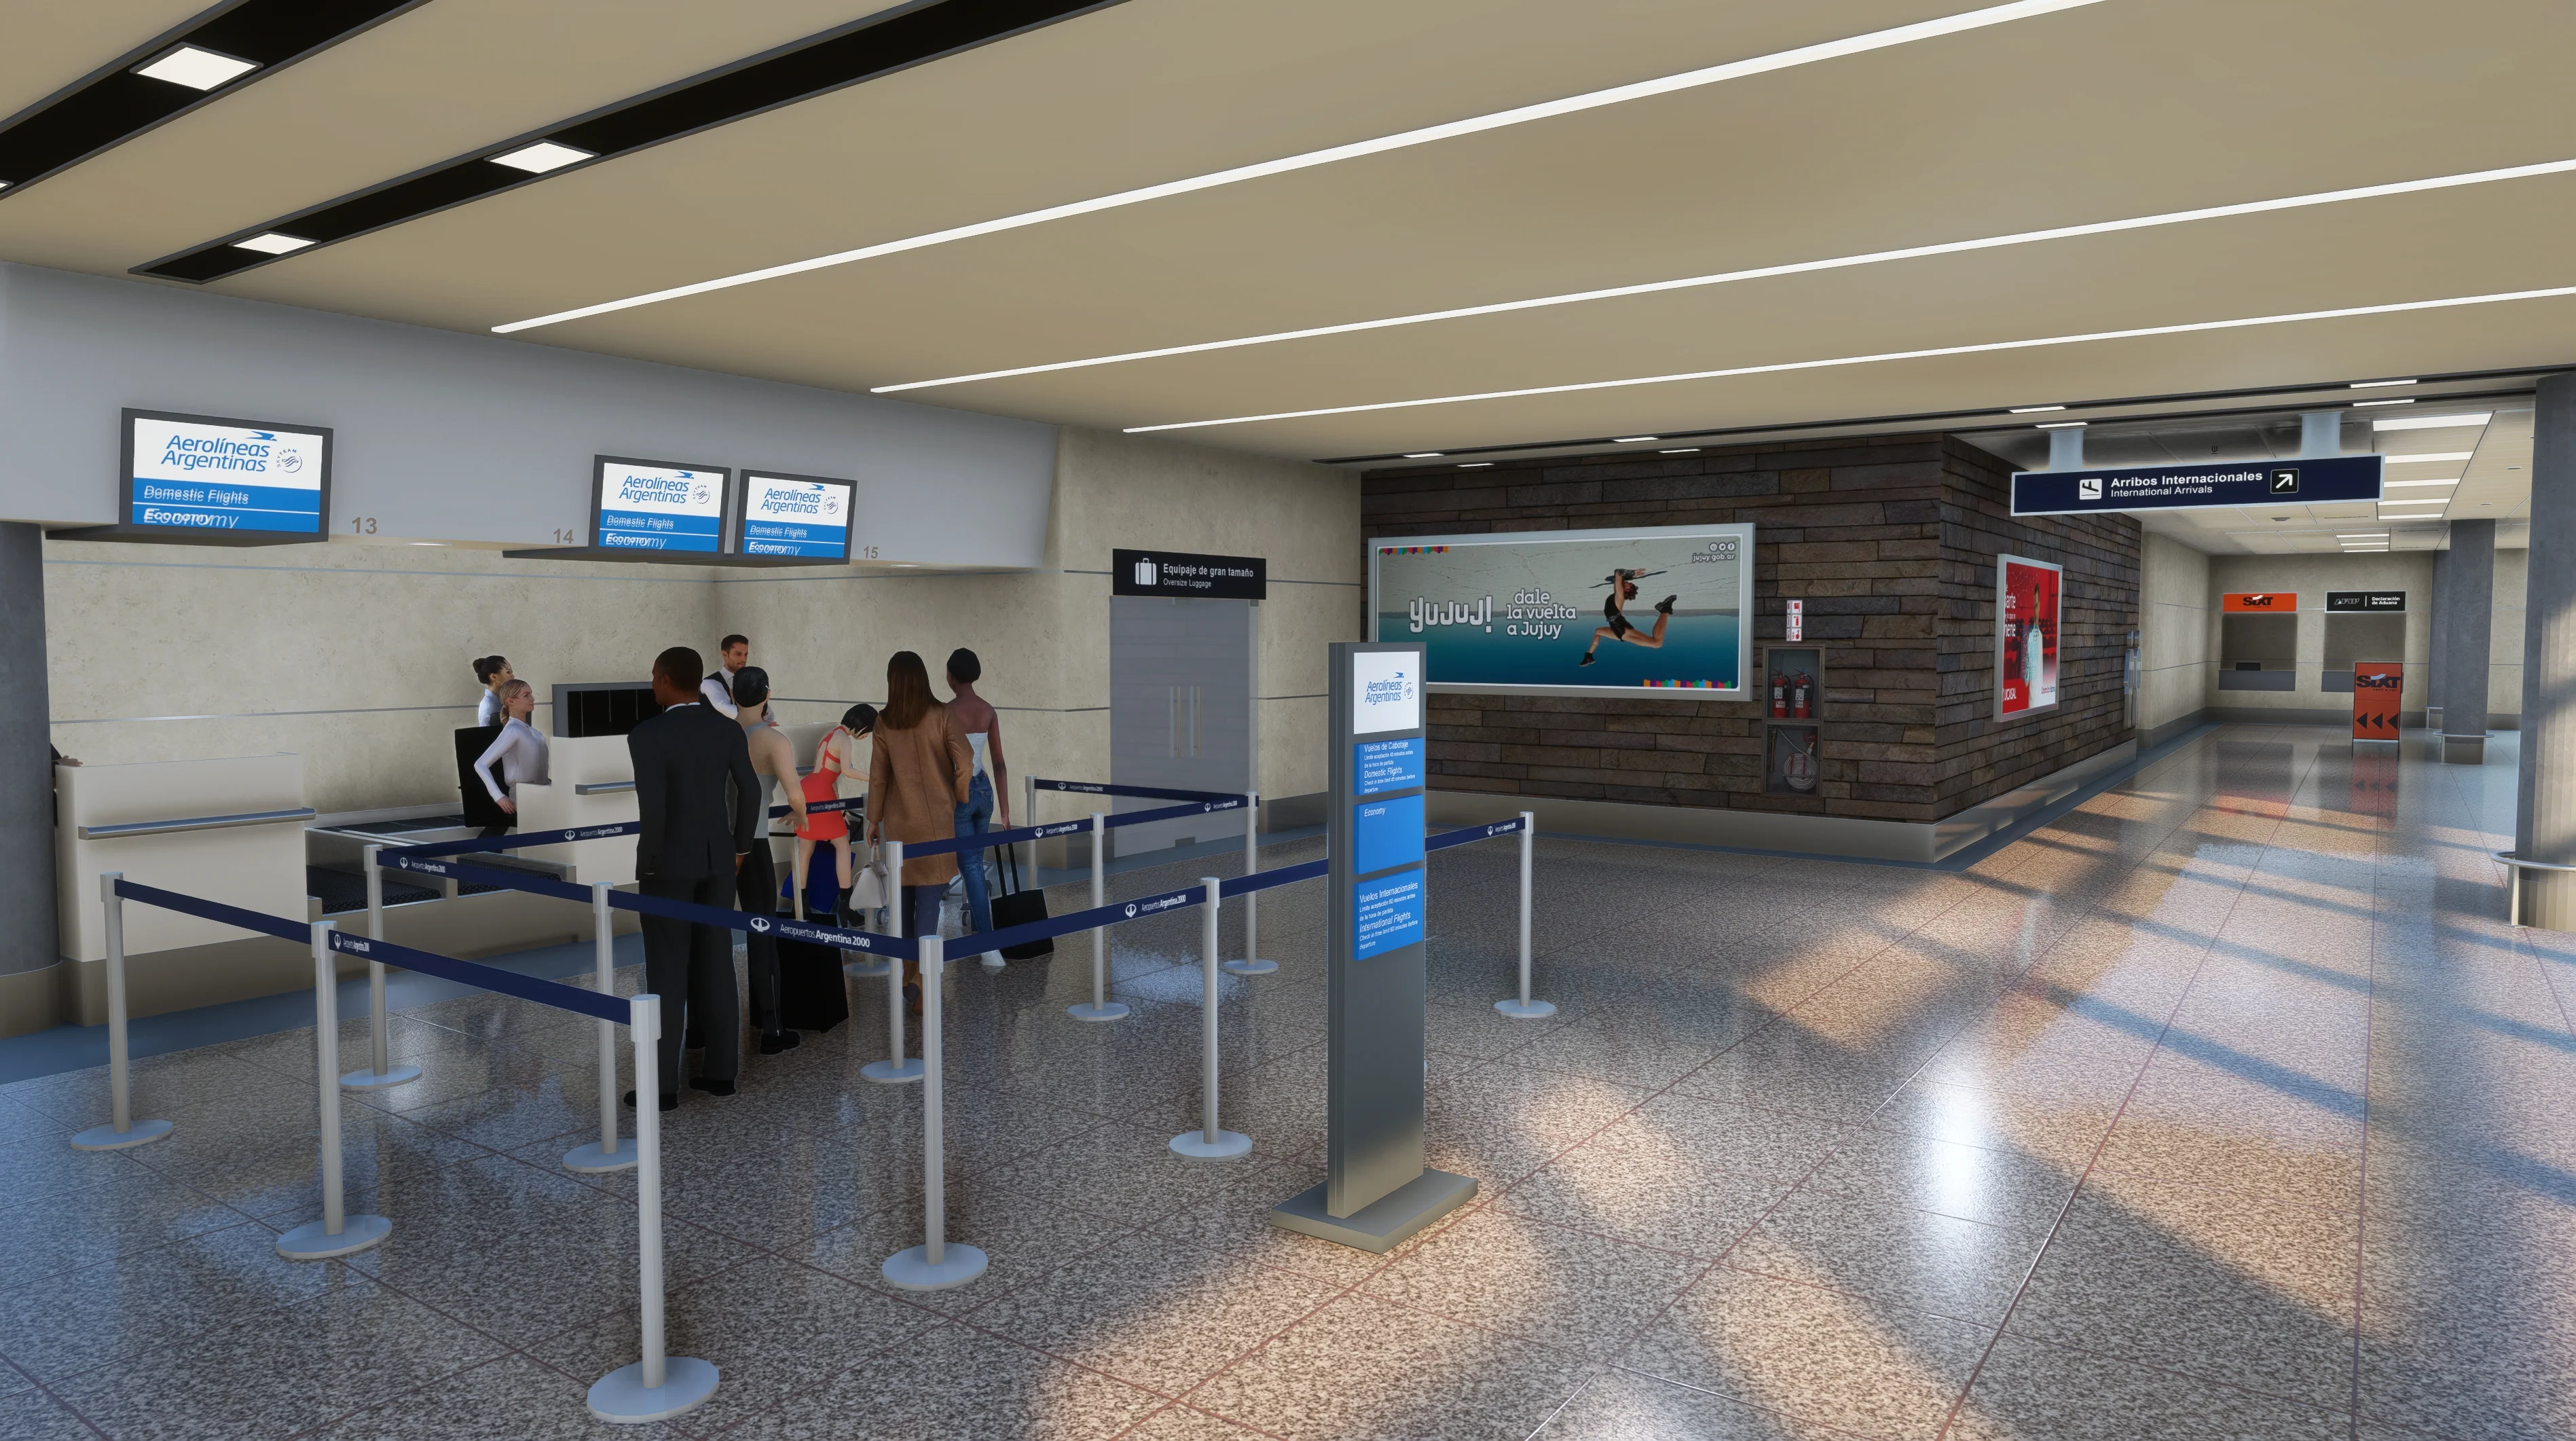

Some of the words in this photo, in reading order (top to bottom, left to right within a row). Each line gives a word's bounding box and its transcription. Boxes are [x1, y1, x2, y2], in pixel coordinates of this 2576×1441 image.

[166, 435, 270, 457] Aerolíneas
[161, 450, 267, 472] Argentinas
[623, 475, 690, 492] Aerolíneas
[2111, 477, 2158, 488] Arribos
[2162, 471, 2263, 485] Internacionales
[619, 488, 687, 503] Argentinas
[764, 488, 821, 503] Aerolíneas
[2111, 487, 2171, 497] International
[2174, 486, 2213, 494] Arrivals
[760, 499, 819, 514] Argentinas
[352, 517, 378, 534] 13
[553, 528, 574, 544] 14
[864, 546, 878, 559] 15
[1693, 553, 1735, 562] jujuy.gob.ar
[1163, 563, 1196, 576] Equipaje
[1198, 566, 1208, 575] de
[1210, 568, 1226, 578] gran
[1228, 567, 1253, 577] tamaño
[1189, 579, 1212, 589] Luggage
[1514, 589, 1550, 604] dale
[1507, 604, 1522, 619] la
[1526, 604, 1576, 619] vuelta
[1507, 624, 1517, 635] a
[1521, 621, 1562, 639] Jujuy
[1366, 679, 1402, 692] Aerolíneas
[1365, 691, 1401, 706] Argentinas
[1364, 744, 1380, 752] Vuelos
[1388, 740, 1408, 750] Cabotaje
[1364, 768, 1386, 778] Domestic
[1387, 766, 1402, 776] Flights
[1365, 807, 1386, 817] Economy
[1359, 892, 1378, 903] Vuelos
[1379, 881, 1418, 898] Internacionales
[1359, 915, 1393, 933] International
[1393, 911, 1411, 923] Flights
[779, 924, 815, 938] Aeropuertos
[815, 930, 851, 945] Argentina
[852, 936, 870, 947] 2000
